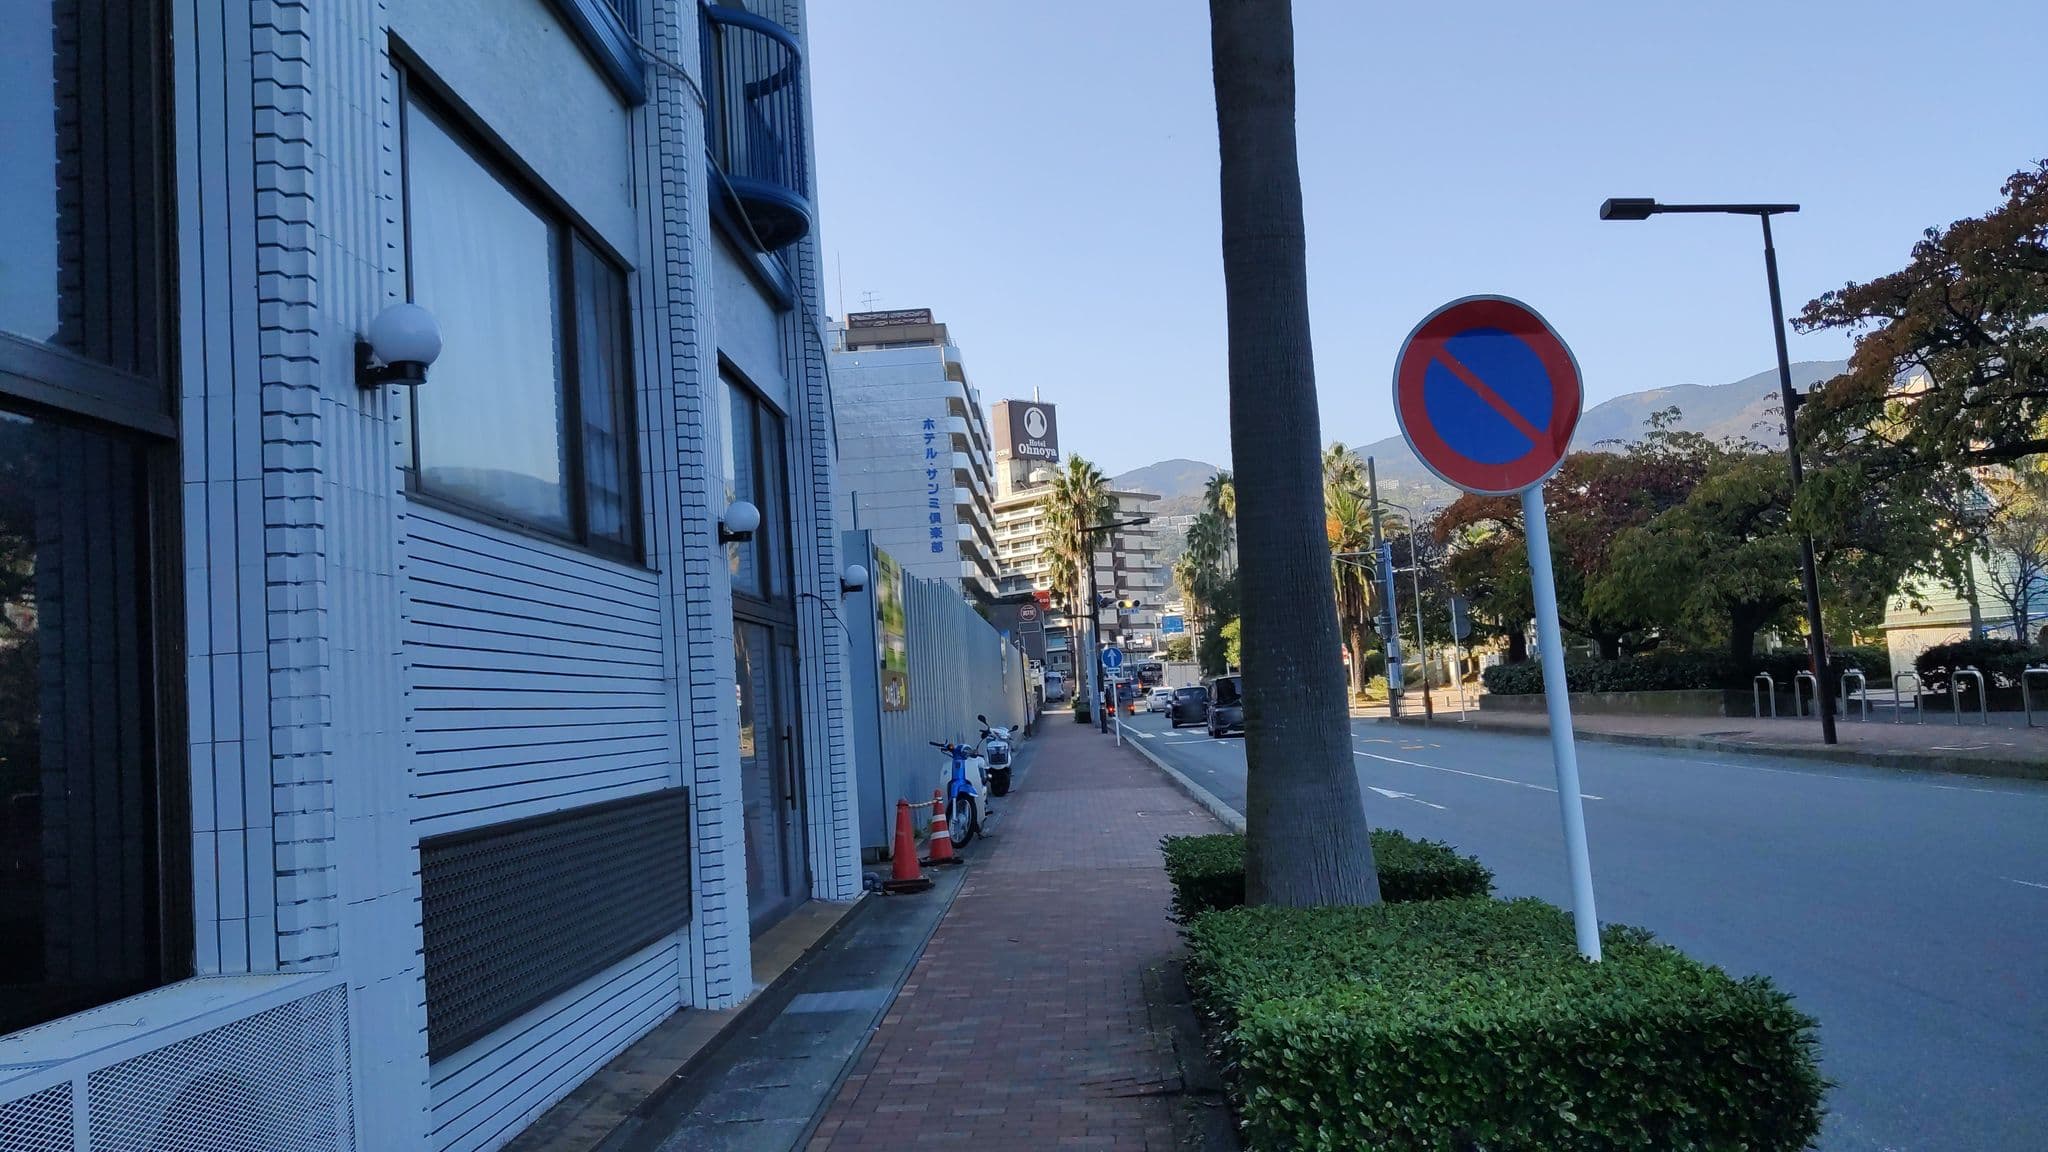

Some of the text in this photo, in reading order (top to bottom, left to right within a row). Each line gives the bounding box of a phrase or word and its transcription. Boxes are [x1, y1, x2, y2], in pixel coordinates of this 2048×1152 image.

[1018, 442, 1057, 459] Ohnoya
[1029, 439, 1046, 448] Hotel
[922, 418, 944, 553] ホテル・サンミ倶楽部
